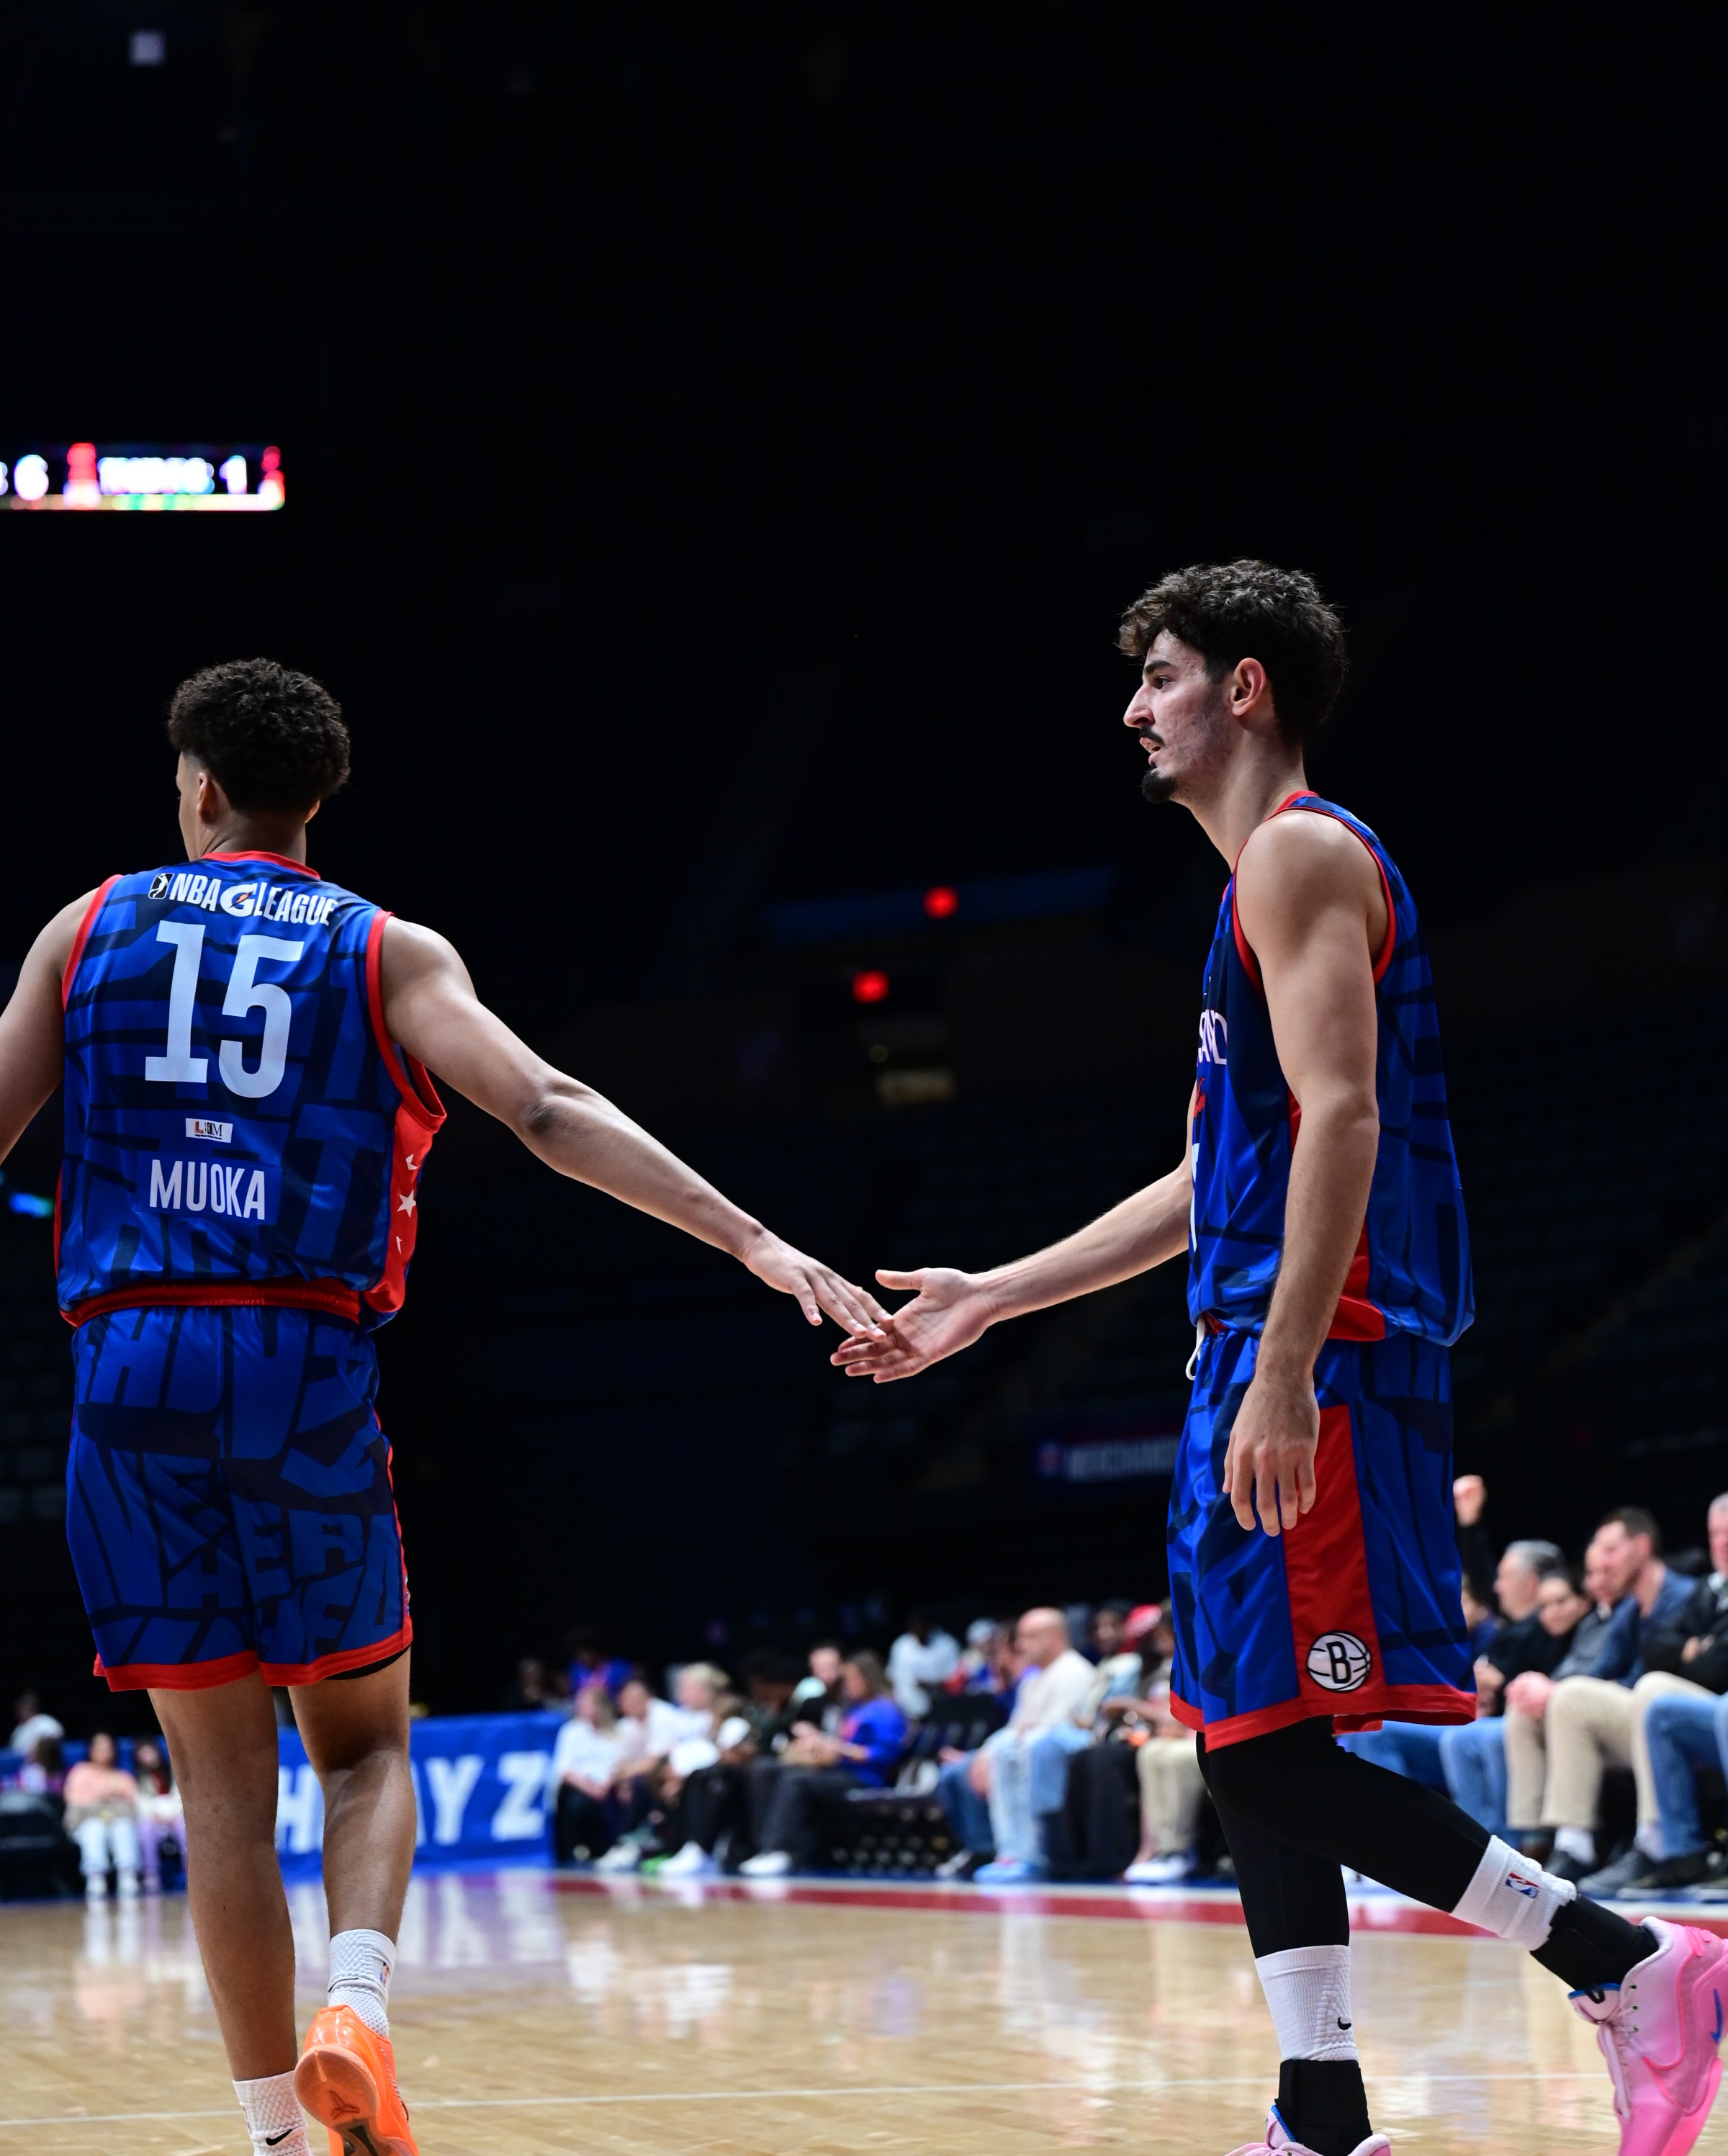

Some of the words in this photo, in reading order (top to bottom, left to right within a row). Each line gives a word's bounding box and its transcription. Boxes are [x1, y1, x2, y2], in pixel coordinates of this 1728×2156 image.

[169, 873, 221, 912] NBA
[220, 882, 257, 917] G
[253, 882, 338, 927] LEAGUE
[145, 920, 305, 1099] 15
[149, 1159, 266, 1221] MUOKA
[1326, 1641, 1351, 1684] B
